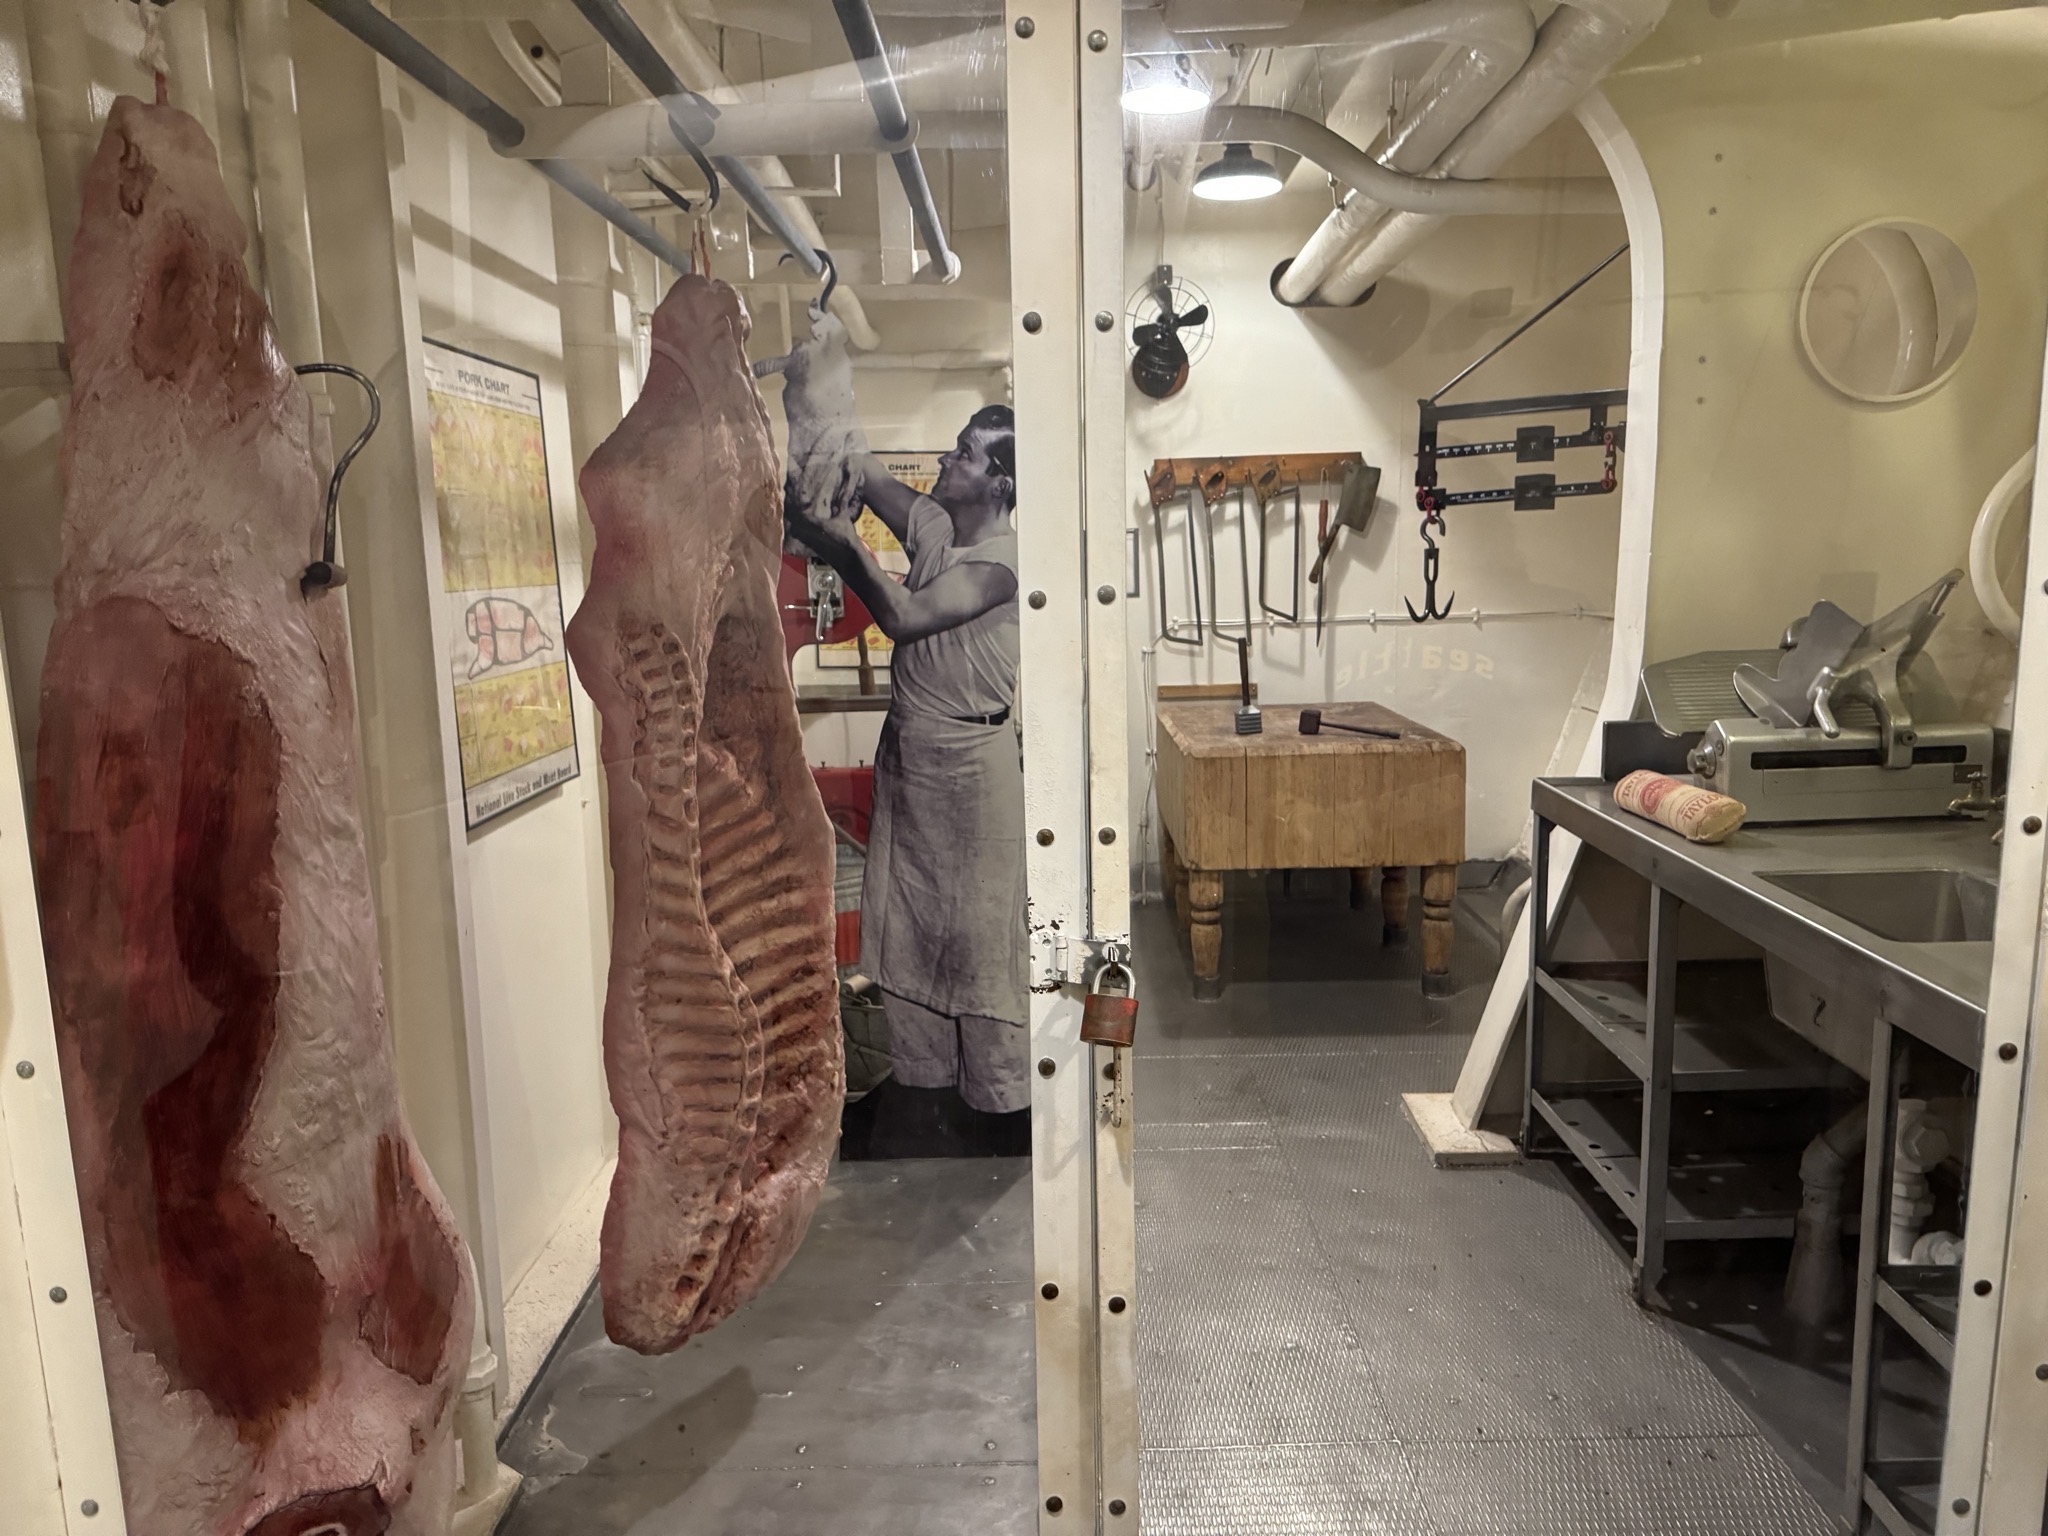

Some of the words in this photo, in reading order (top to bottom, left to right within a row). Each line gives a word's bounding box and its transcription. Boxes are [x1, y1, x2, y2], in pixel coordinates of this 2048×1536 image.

[458, 370, 483, 387] PORK
[484, 377, 510, 396] CHART
[475, 794, 502, 817] National
[503, 791, 515, 806] Live
[515, 782, 531, 799] Stock
[532, 776, 542, 790] and
[543, 769, 556, 784] Meat
[557, 763, 572, 780] Board
